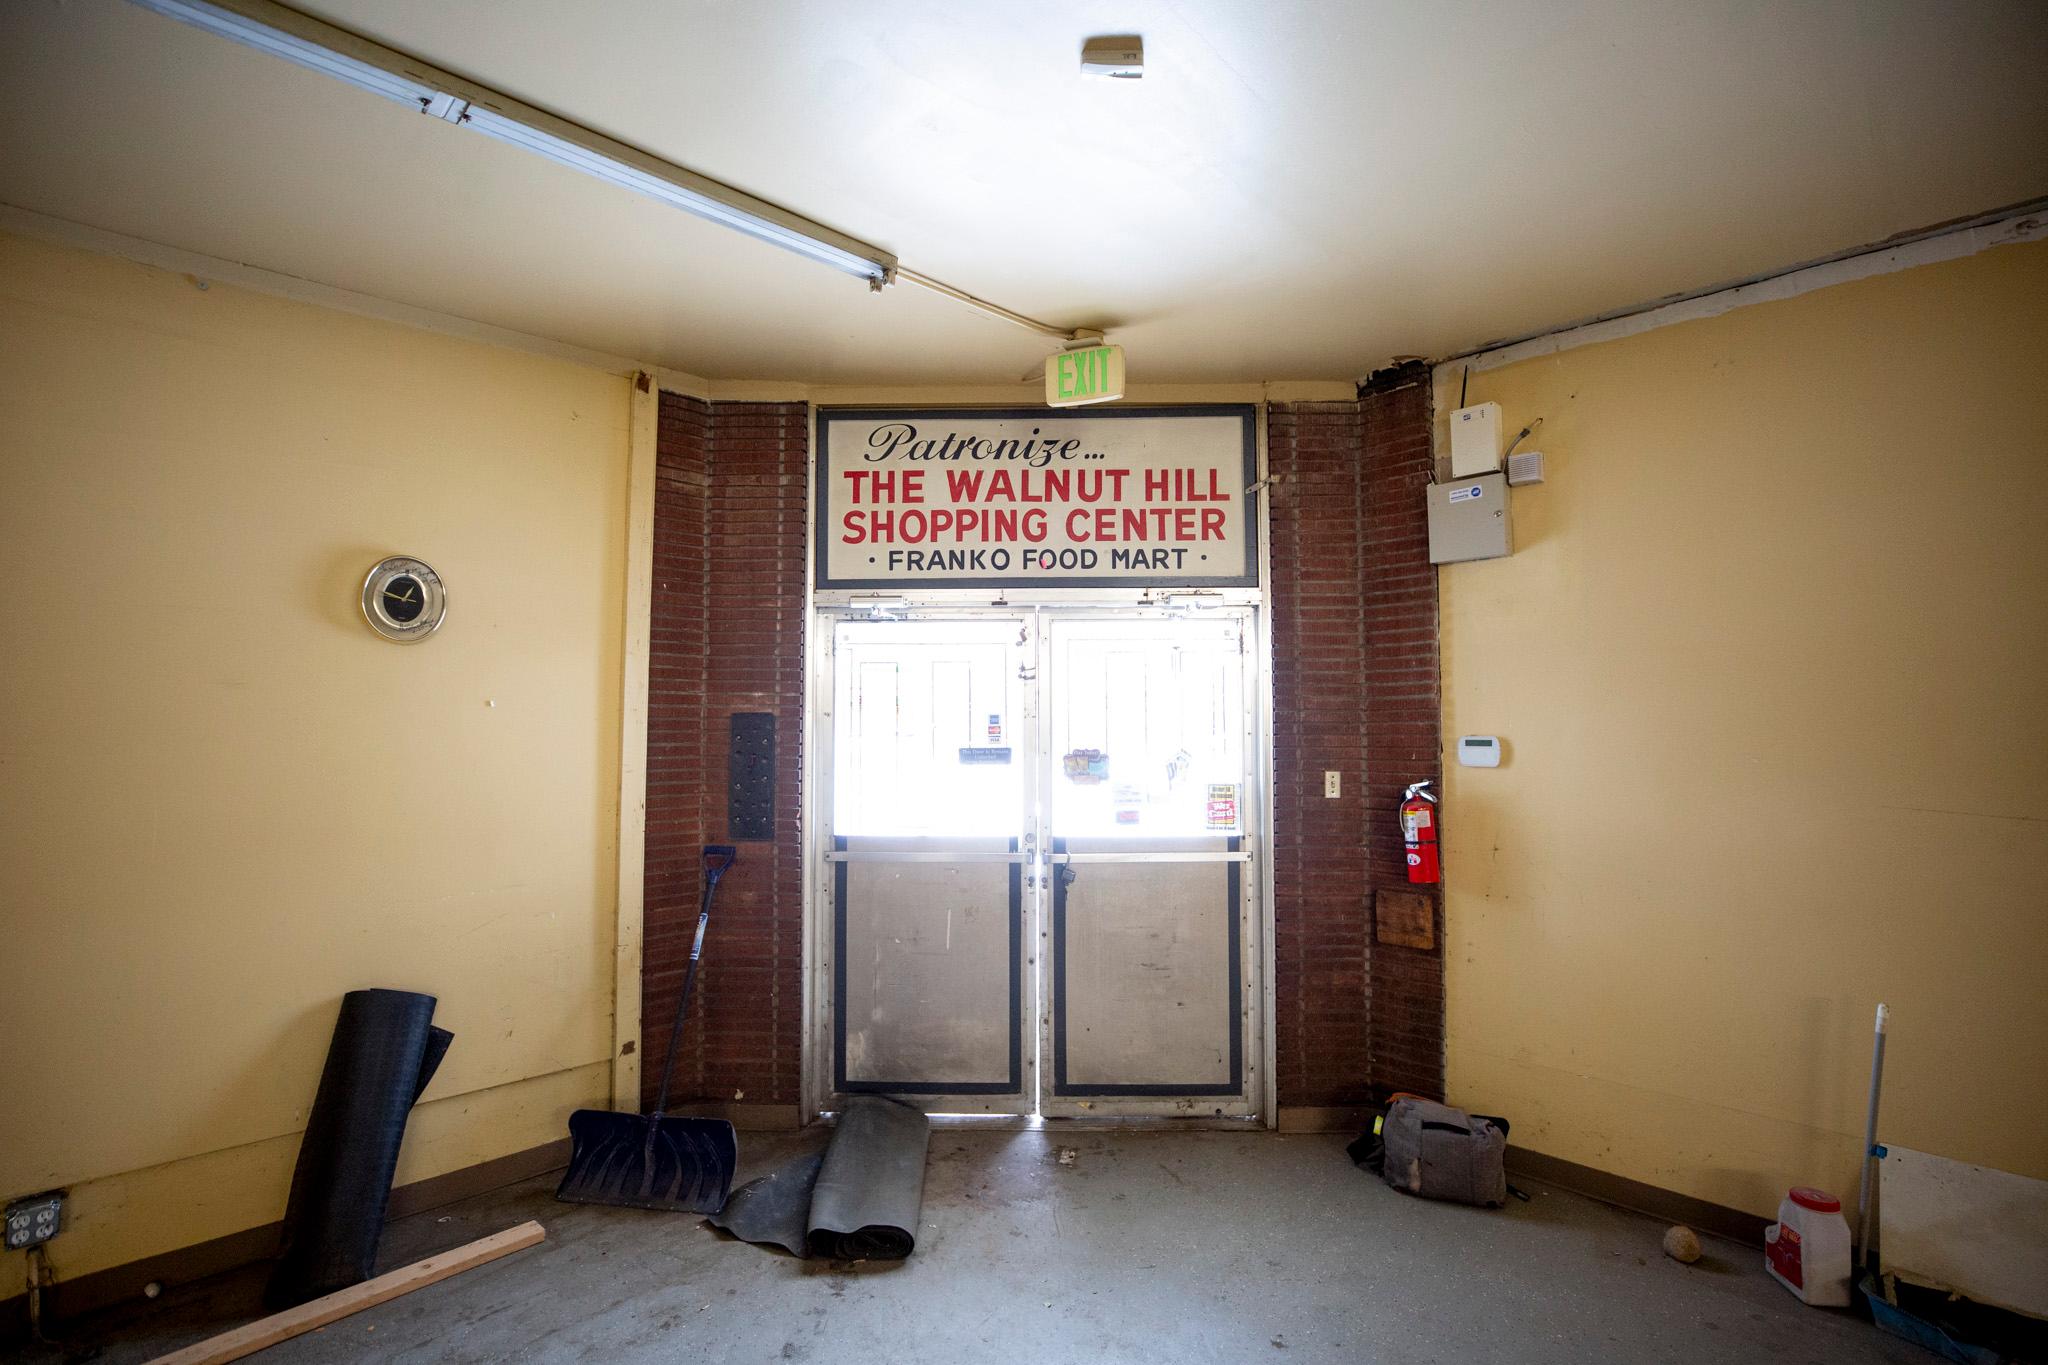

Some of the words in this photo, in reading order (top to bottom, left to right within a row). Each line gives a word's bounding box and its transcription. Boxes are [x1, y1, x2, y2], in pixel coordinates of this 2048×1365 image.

[1057, 348, 1112, 399] EXIT
[863, 423, 1105, 468] Patronize...
[842, 469, 925, 504] THE
[946, 468, 1131, 503] WALNUT
[1144, 468, 1231, 503] HILL
[842, 508, 1048, 545] SHOPPING
[1065, 507, 1227, 543] CENTER
[888, 548, 1011, 571] FRANKO
[1022, 548, 1098, 570] FOOD
[1111, 548, 1189, 570] MART
